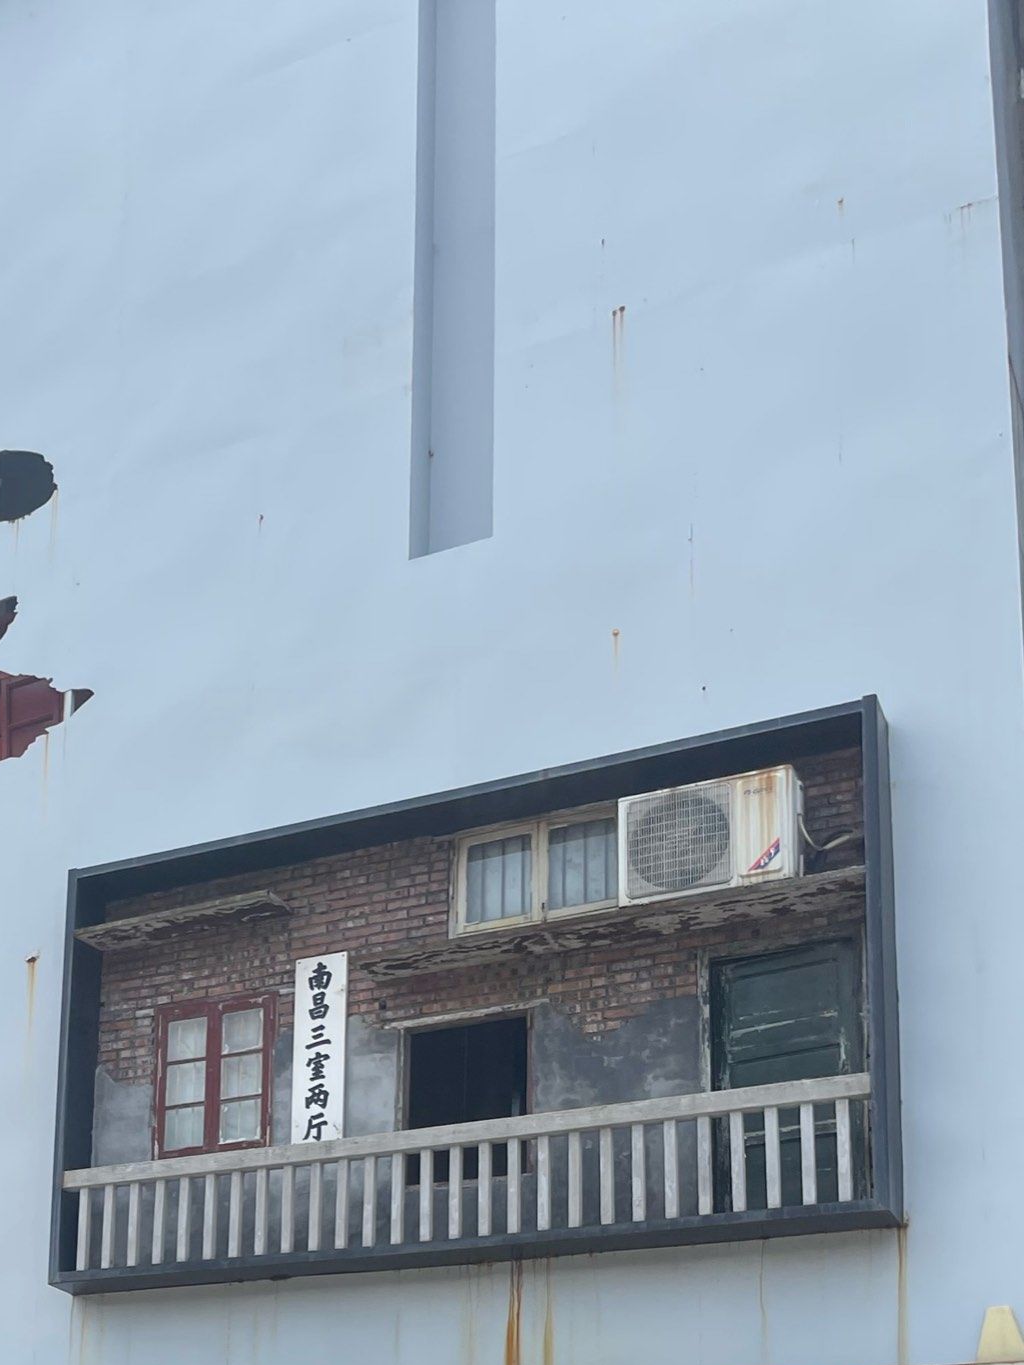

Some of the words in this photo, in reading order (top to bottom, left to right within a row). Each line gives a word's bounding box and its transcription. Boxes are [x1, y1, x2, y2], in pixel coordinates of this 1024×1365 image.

[303, 962, 332, 1141] 南昌三室两厅
